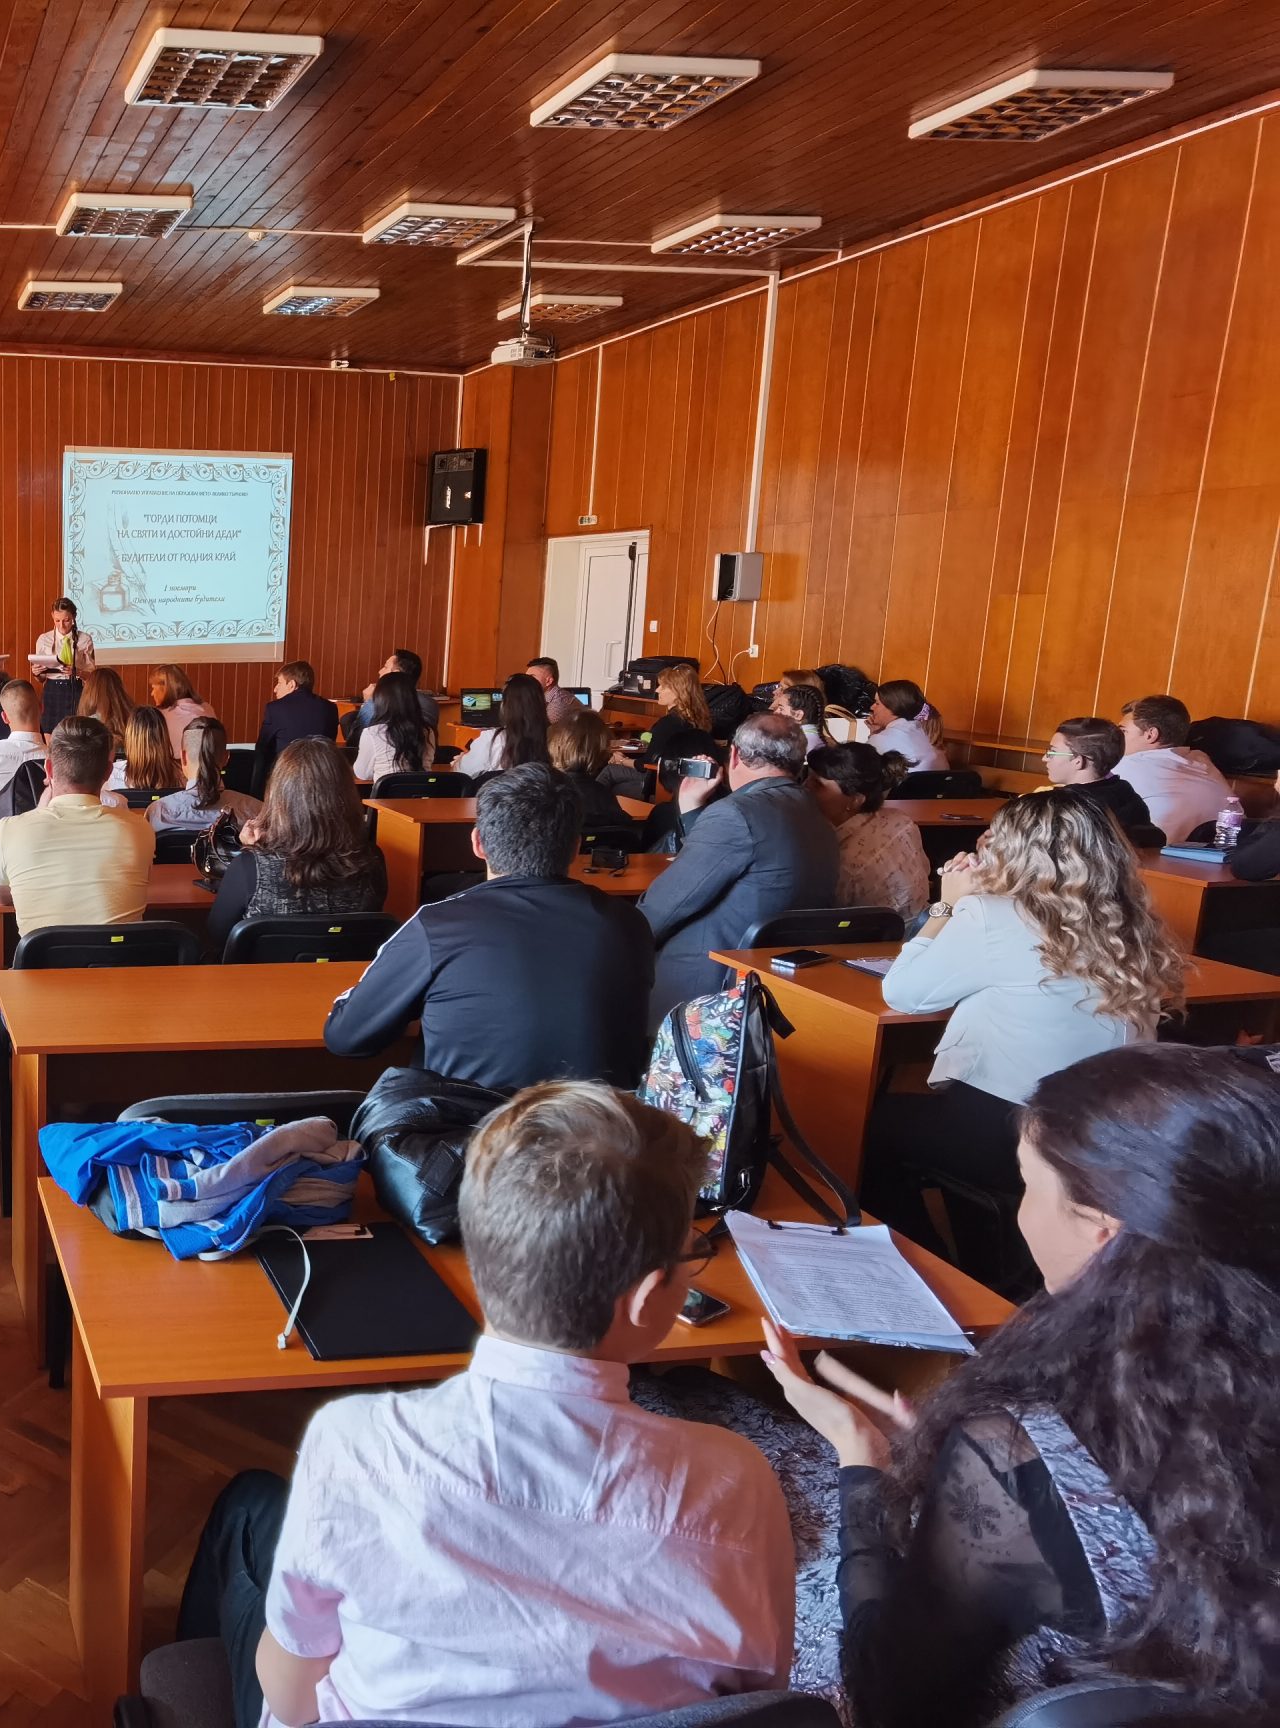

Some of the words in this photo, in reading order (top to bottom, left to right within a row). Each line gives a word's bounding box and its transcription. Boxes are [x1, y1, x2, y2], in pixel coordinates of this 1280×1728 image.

[176, 515, 217, 524] ПОТОМЦИ
[117, 530, 130, 539] НА
[131, 530, 158, 539] СВЯТИ
[159, 531, 167, 539] И
[167, 528, 214, 540] ДОСТОЙНИ
[122, 553, 166, 564] БУДИТЕЛИ
[167, 553, 178, 562] ОТ
[180, 553, 213, 563] РОДНИЯ
[214, 551, 236, 562] КРАЙ
